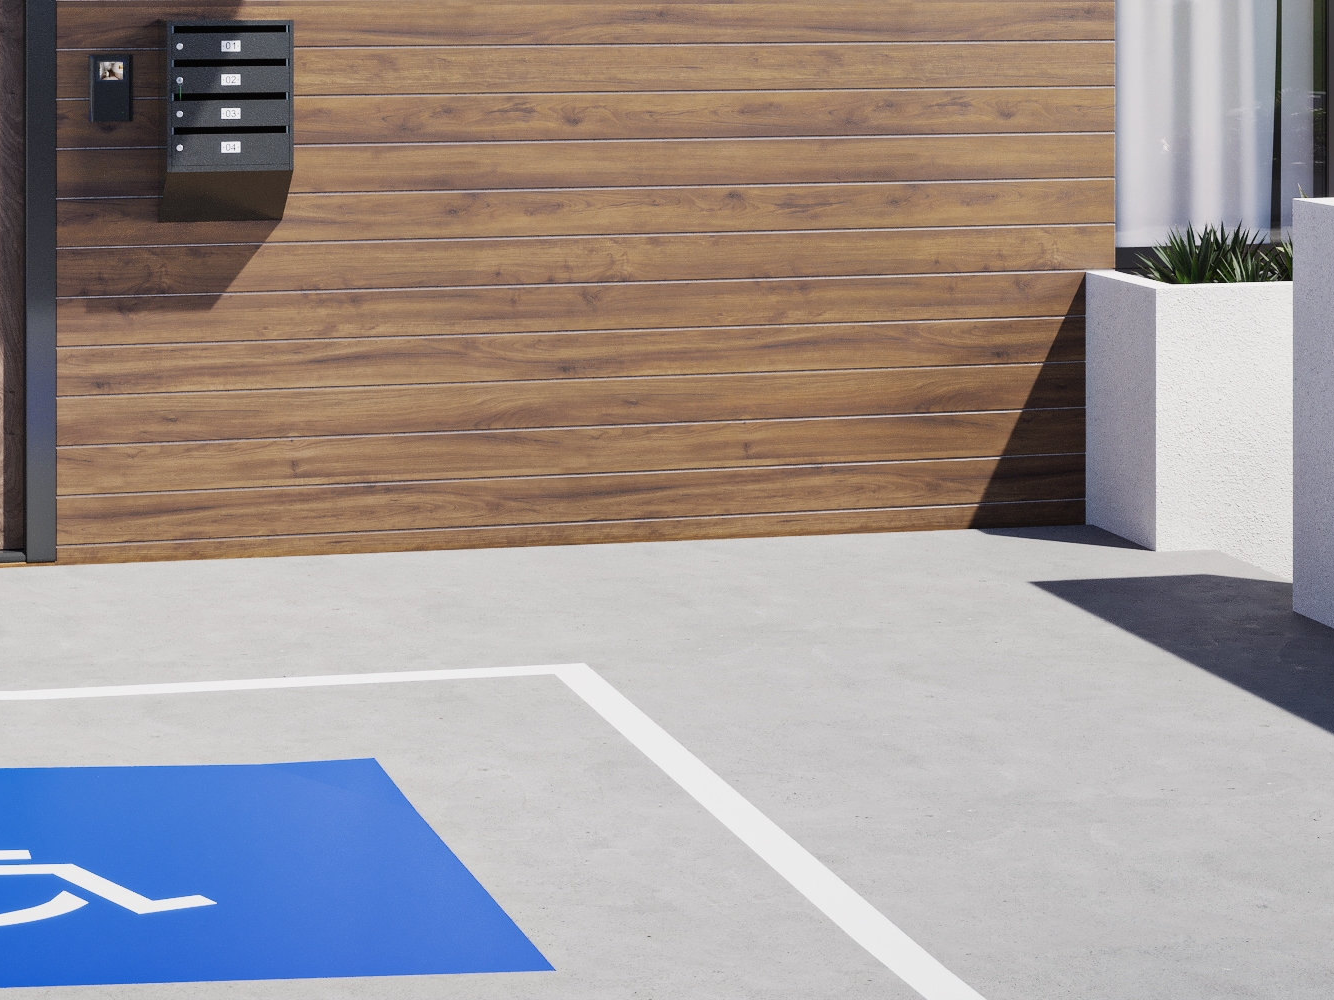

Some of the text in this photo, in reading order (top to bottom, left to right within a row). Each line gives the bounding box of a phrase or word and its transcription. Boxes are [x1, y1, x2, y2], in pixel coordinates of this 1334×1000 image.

[225, 41, 236, 50] 01
[225, 75, 237, 84] 02
[225, 109, 237, 118] 03
[225, 143, 236, 152] 04
